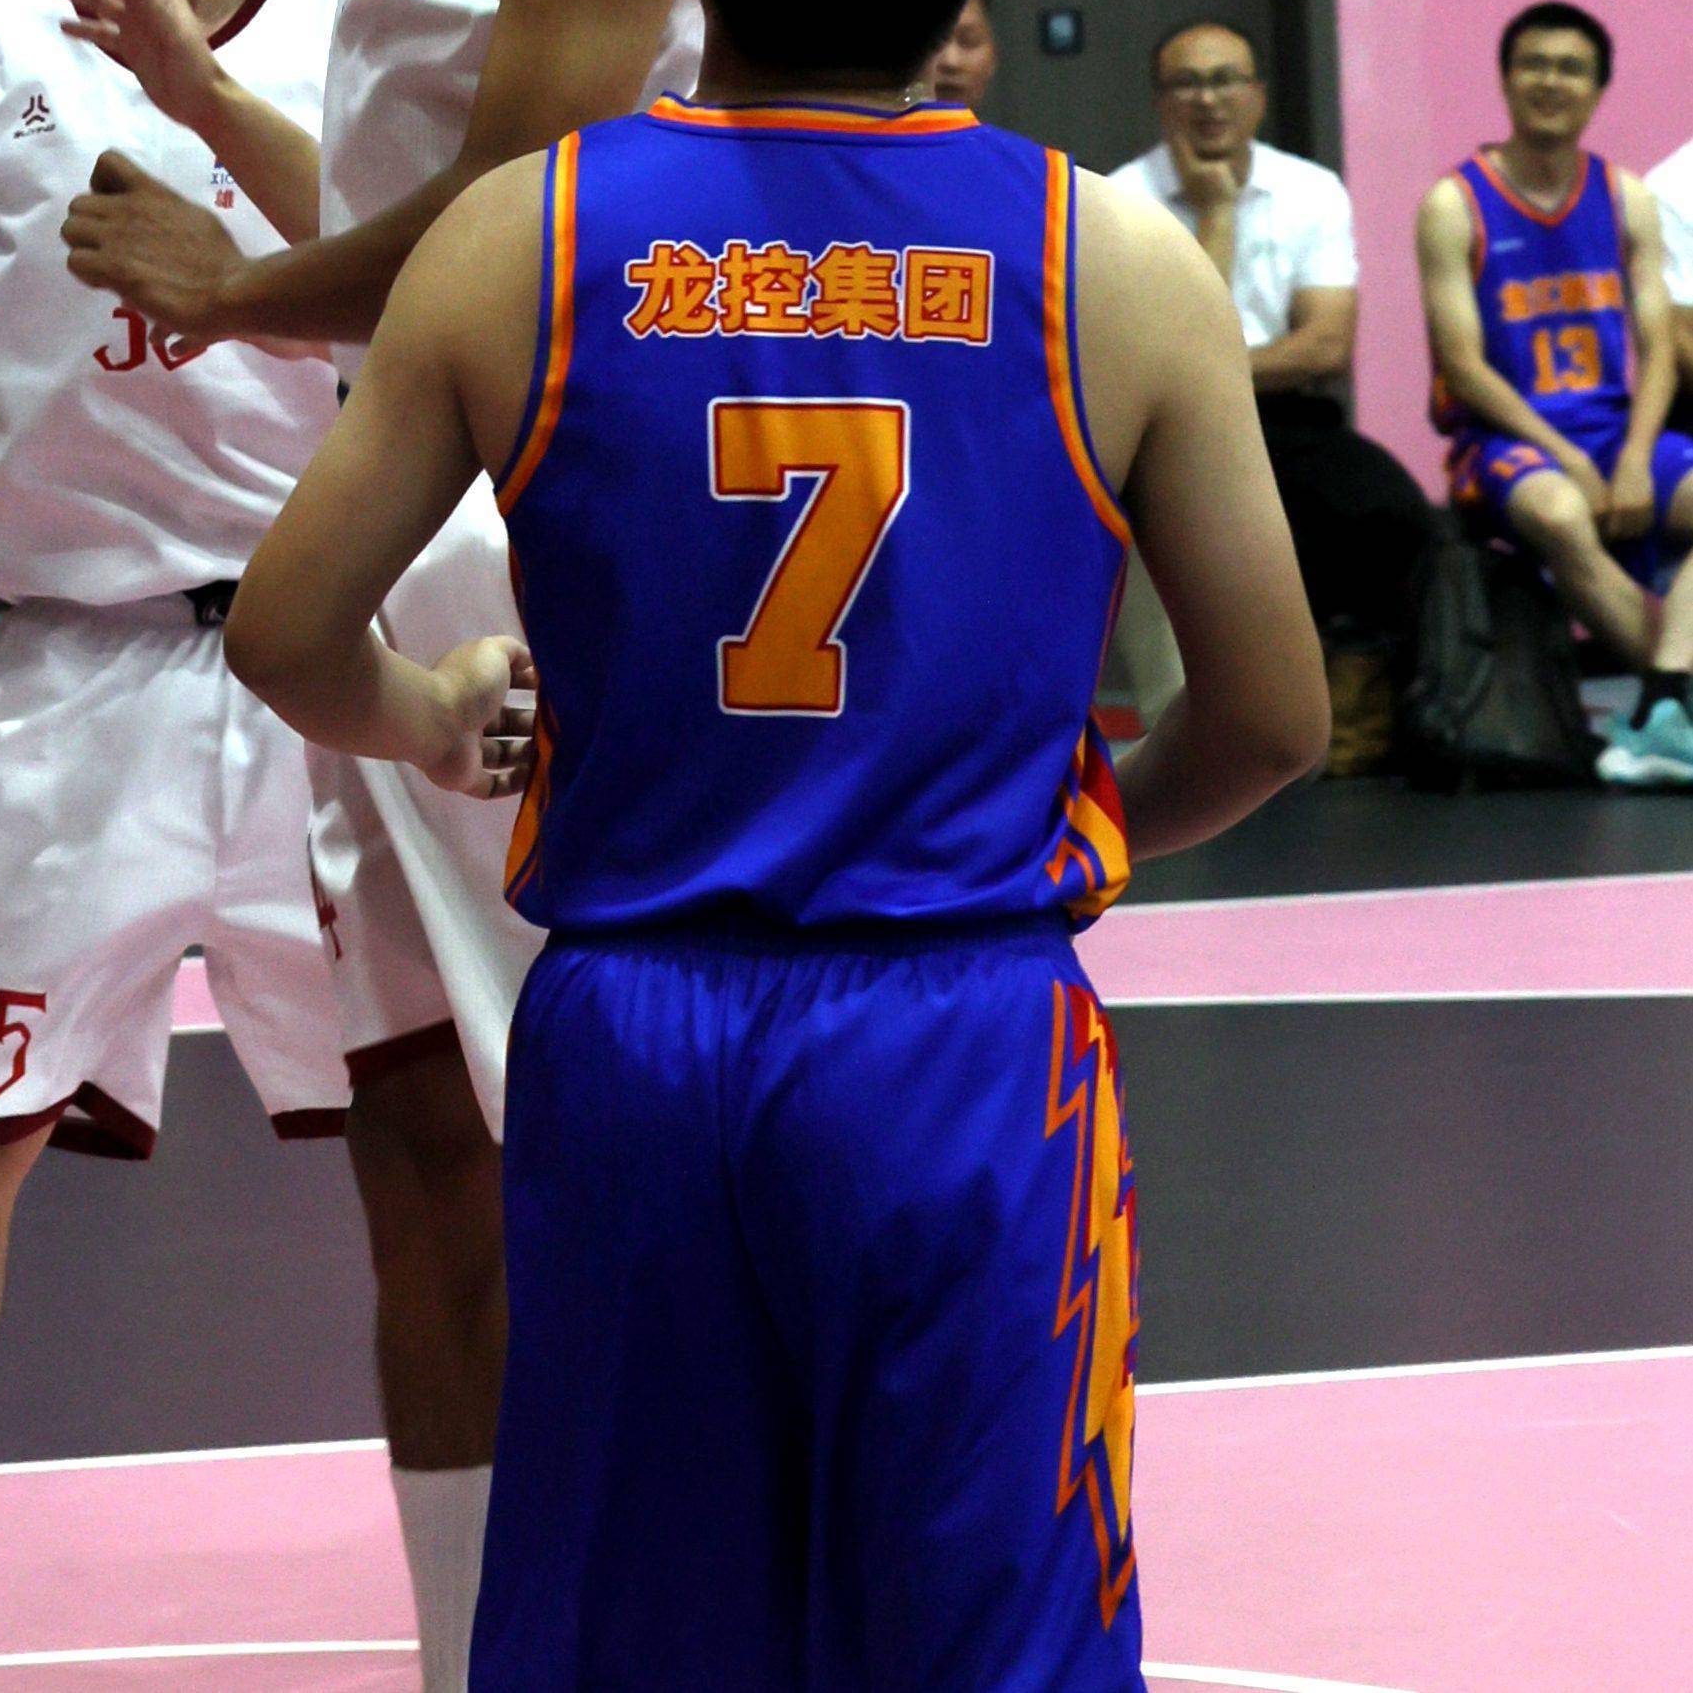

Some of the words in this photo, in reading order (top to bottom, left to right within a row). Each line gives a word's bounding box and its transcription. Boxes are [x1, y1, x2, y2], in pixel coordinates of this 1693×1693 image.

[624, 240, 994, 347] 龙控集团
[1533, 325, 1602, 395] 13
[707, 397, 912, 718] 7
